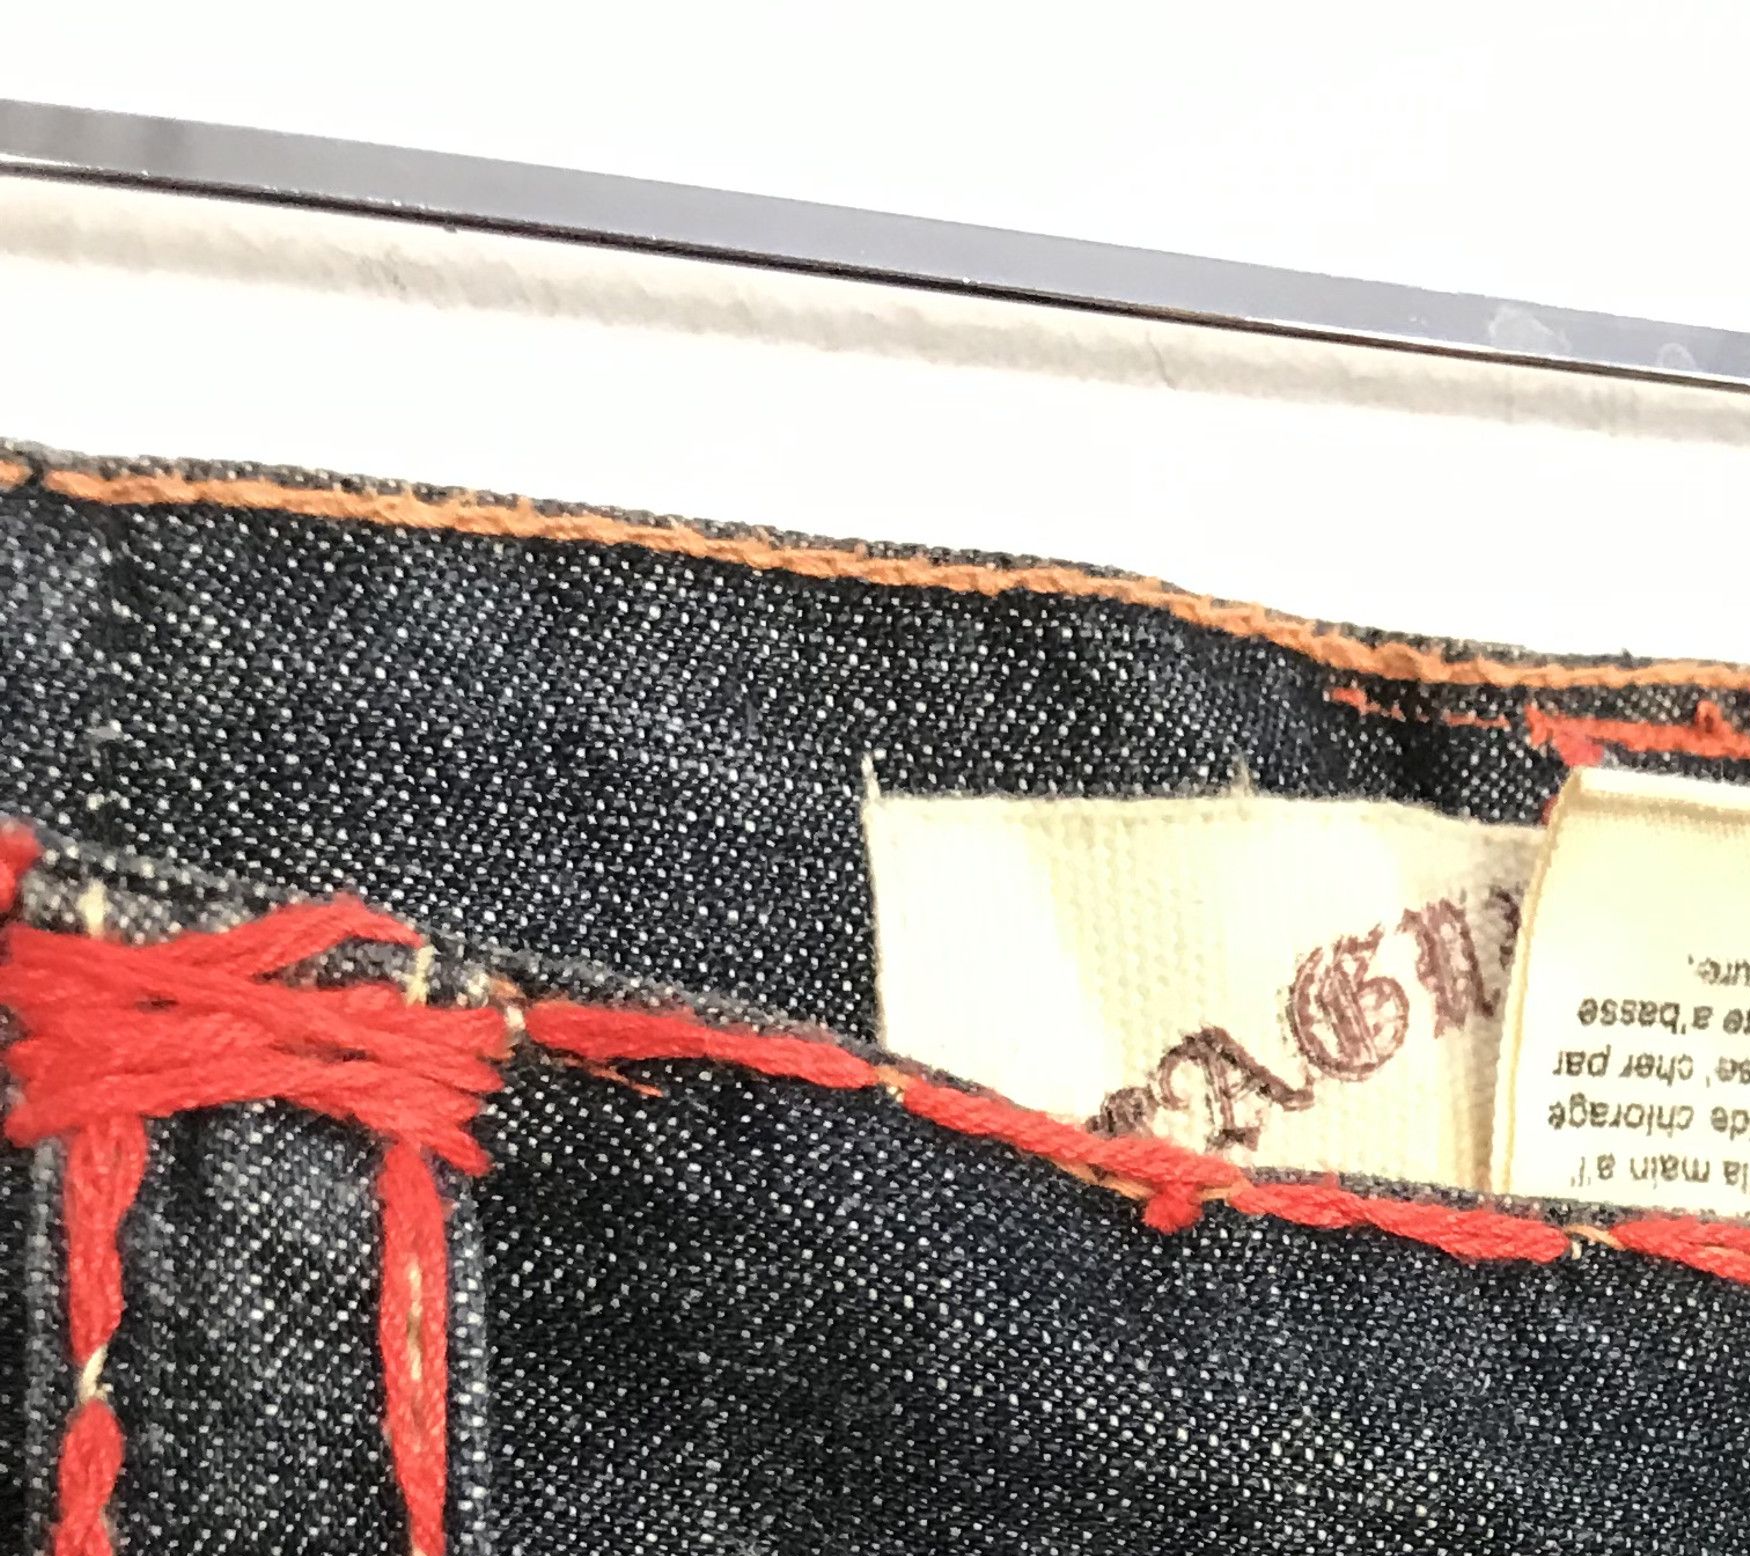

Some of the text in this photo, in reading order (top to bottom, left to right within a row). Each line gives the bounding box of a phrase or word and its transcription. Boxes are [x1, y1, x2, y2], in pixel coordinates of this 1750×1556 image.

[1577, 999, 1713, 1034] a'basse
[1553, 1045, 1611, 1077] par
[1619, 1053, 1693, 1086] cher
[1548, 1093, 1694, 1136] chlorage
[1630, 1155, 1710, 1188] main
